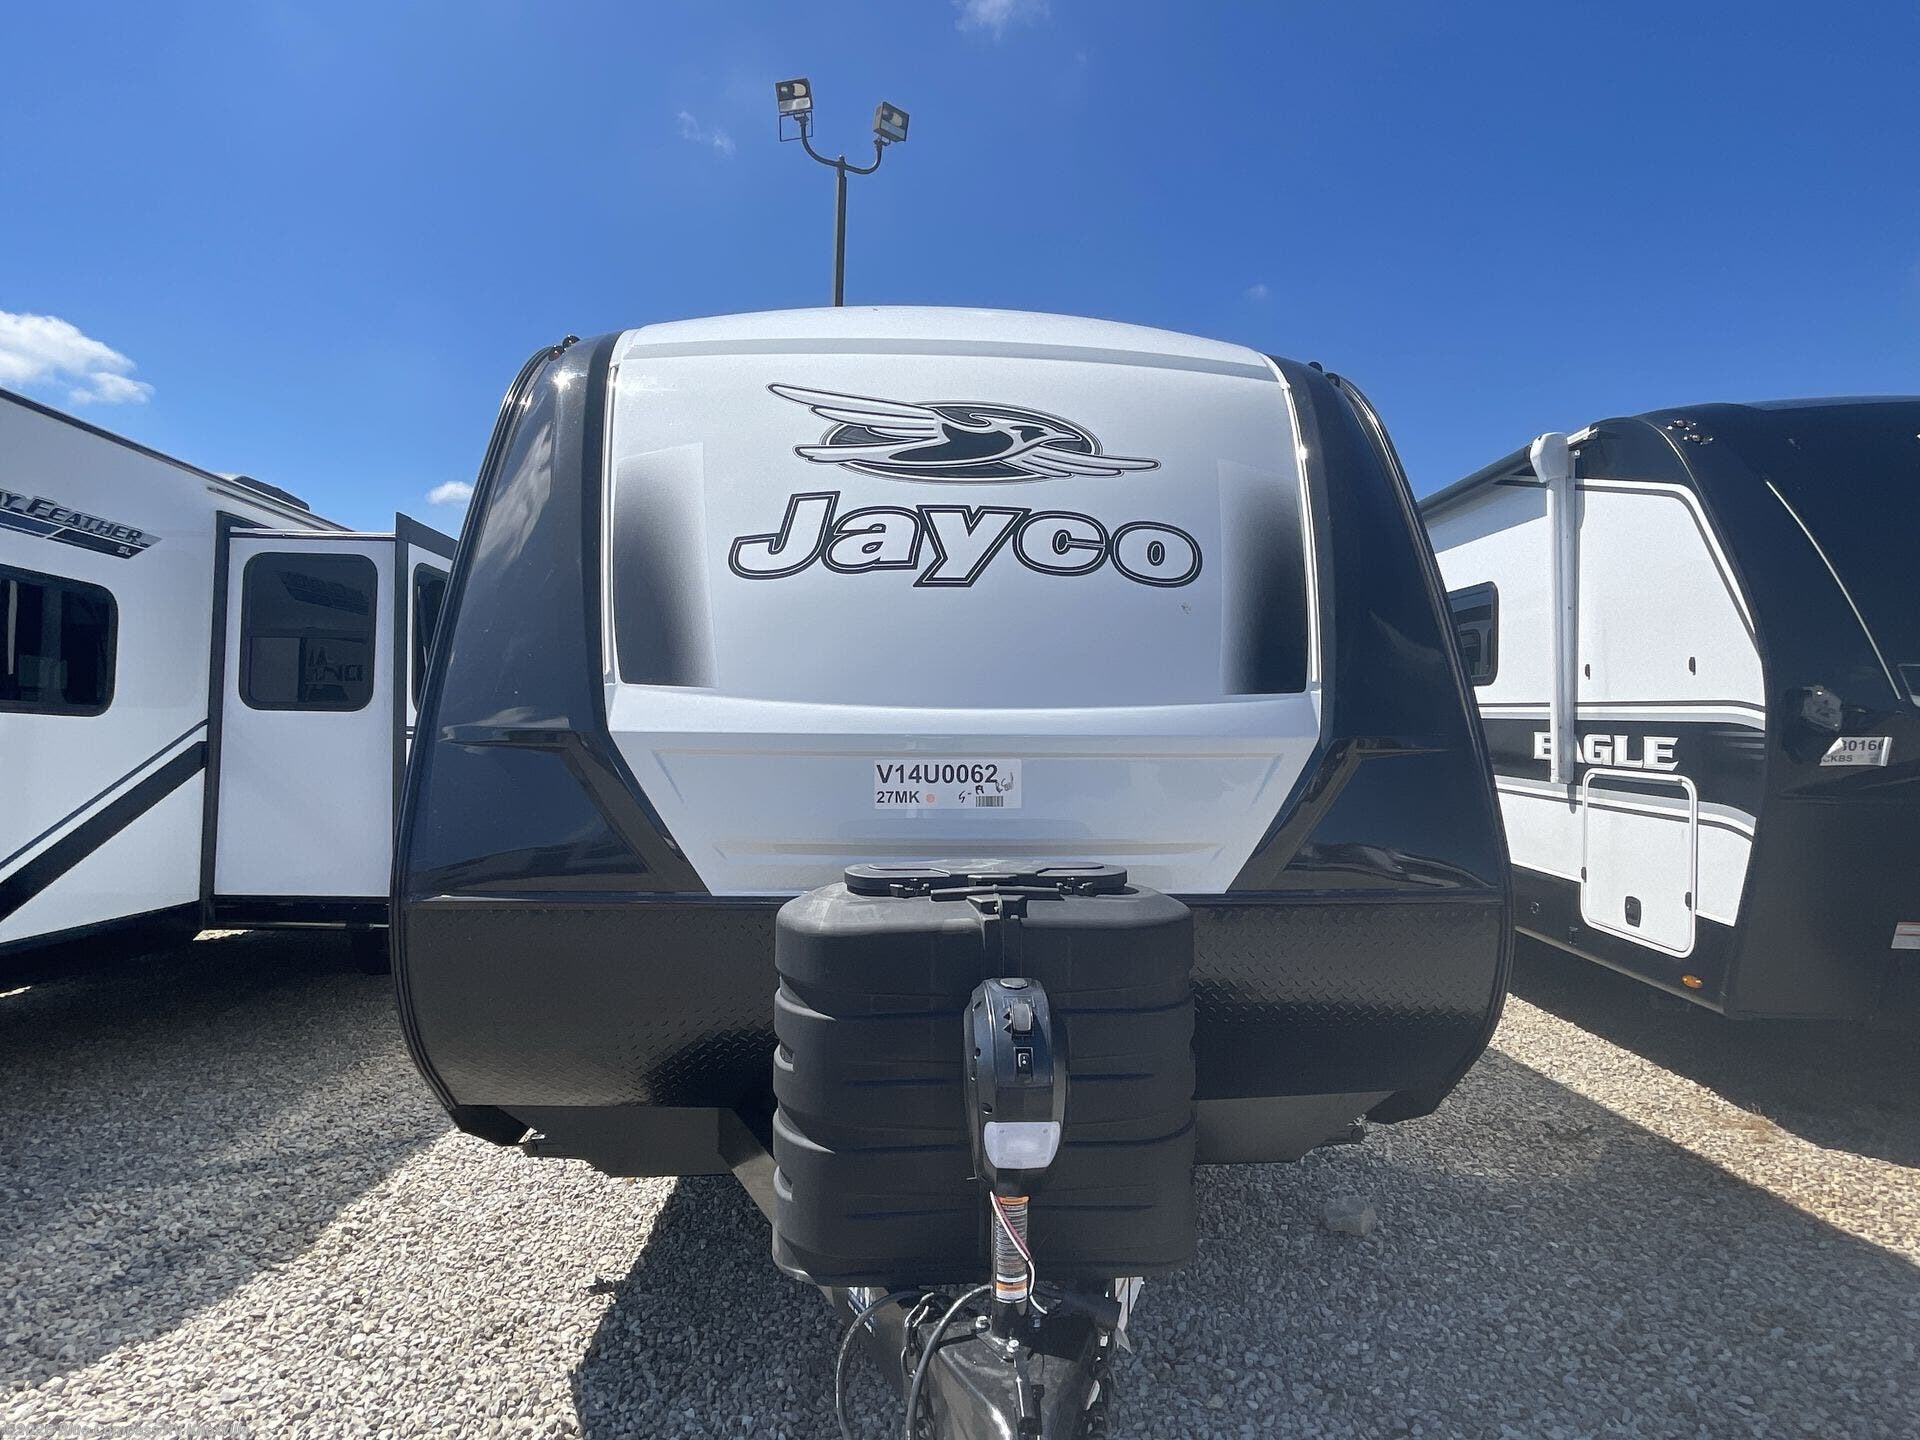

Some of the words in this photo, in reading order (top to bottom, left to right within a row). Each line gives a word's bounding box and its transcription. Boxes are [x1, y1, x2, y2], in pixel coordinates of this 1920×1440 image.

[26, 497, 145, 546] FEATHER
[728, 491, 1202, 587] Jayco
[1533, 731, 1679, 771] EGLE
[876, 764, 998, 784] V14U0062
[876, 791, 920, 804] 27MK
